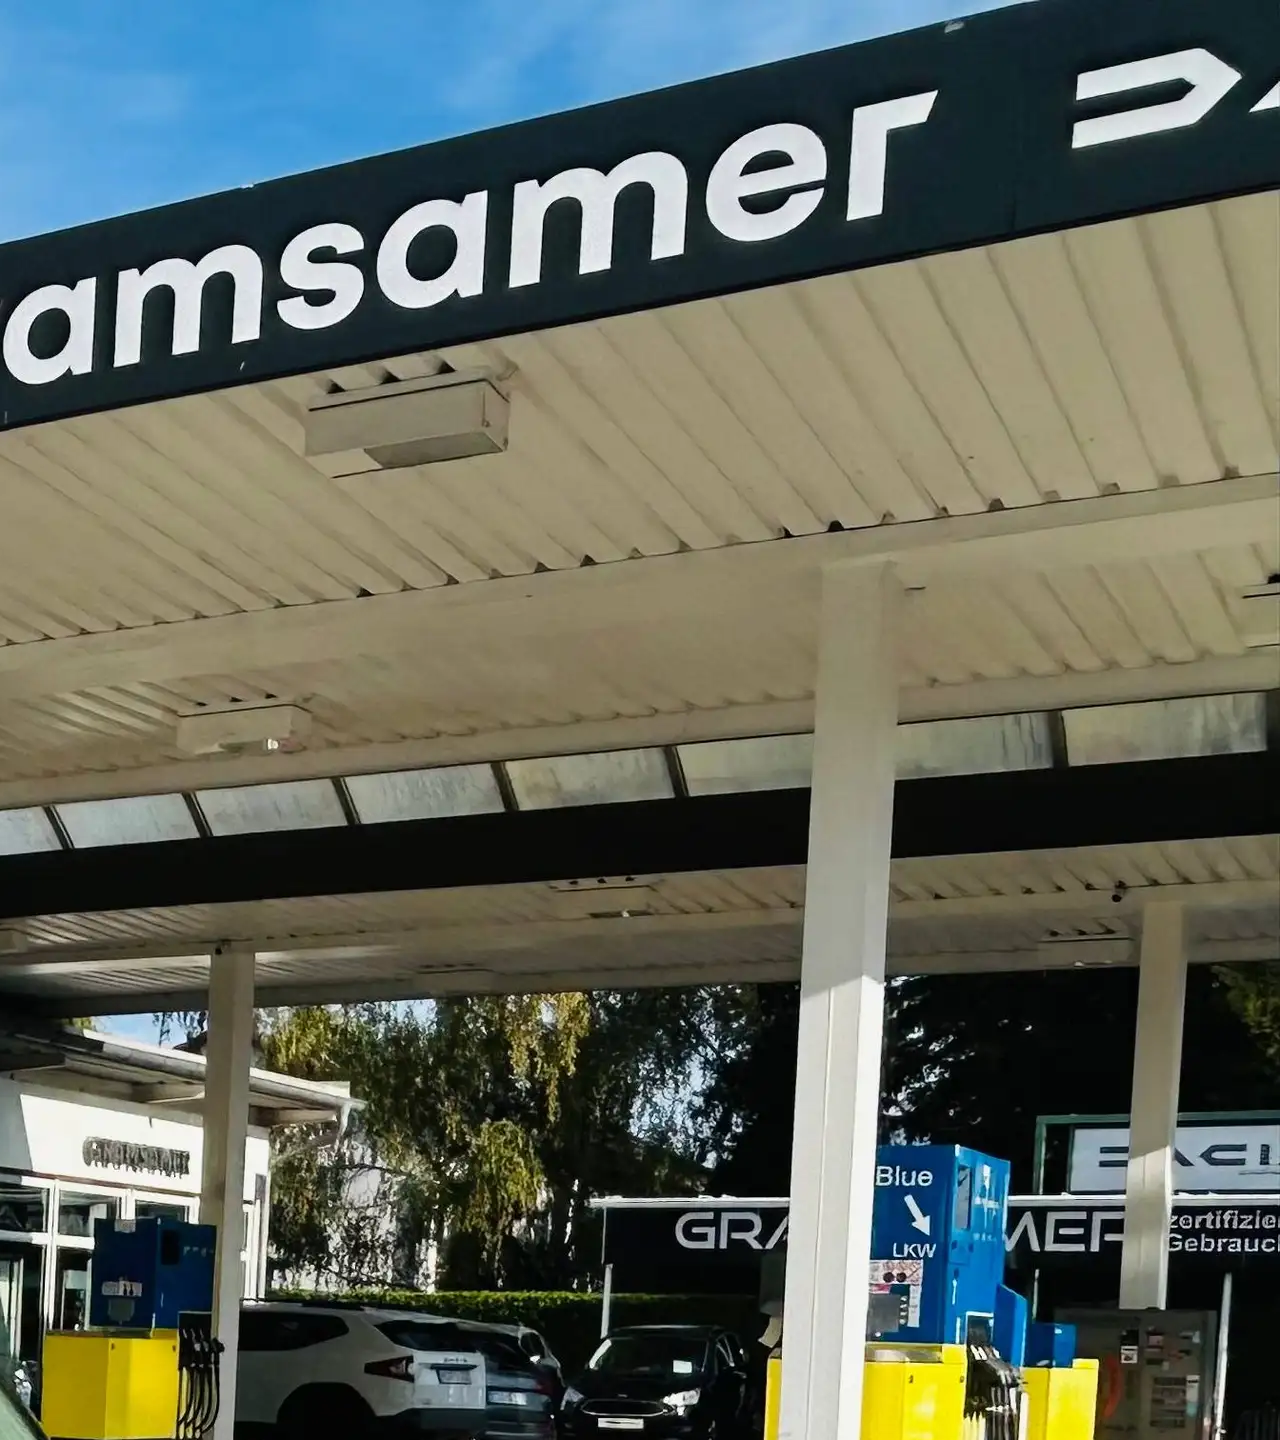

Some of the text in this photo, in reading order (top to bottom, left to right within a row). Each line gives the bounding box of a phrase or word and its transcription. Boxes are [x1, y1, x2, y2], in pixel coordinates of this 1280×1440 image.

[875, 1165, 934, 1188] Blue
[1170, 1209, 1280, 1229] zertifizie
[892, 1243, 937, 1258] LKW
[1169, 1233, 1280, 1252] Gebrauc
